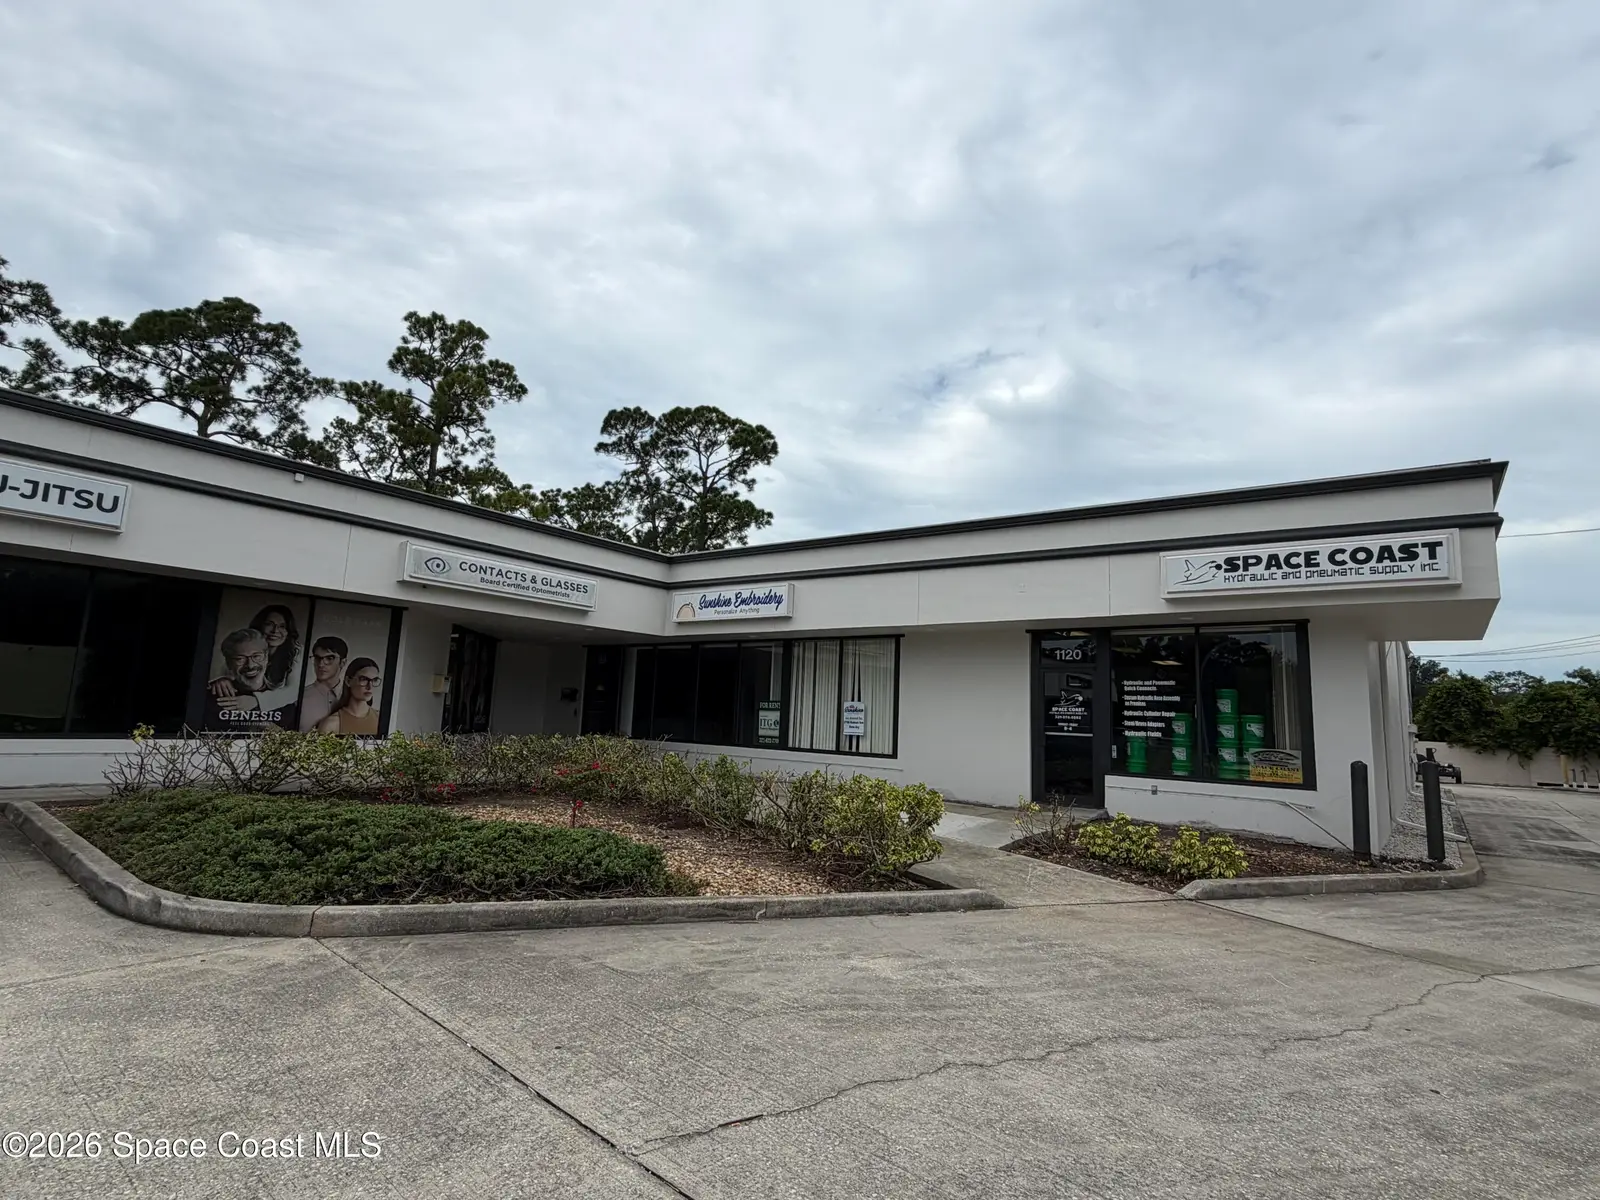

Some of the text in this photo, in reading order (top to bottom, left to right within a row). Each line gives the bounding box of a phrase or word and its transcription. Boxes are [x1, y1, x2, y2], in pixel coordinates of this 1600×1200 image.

[1223, 541, 1444, 573] SPACE COAST
[459, 561, 589, 594] CONTACTS & GLASSES
[480, 577, 571, 599] Board Certified Optometrists
[698, 588, 784, 612] Sunshine Embroidery
[1054, 649, 1082, 660] 1120
[219, 710, 282, 721] GENESIS
